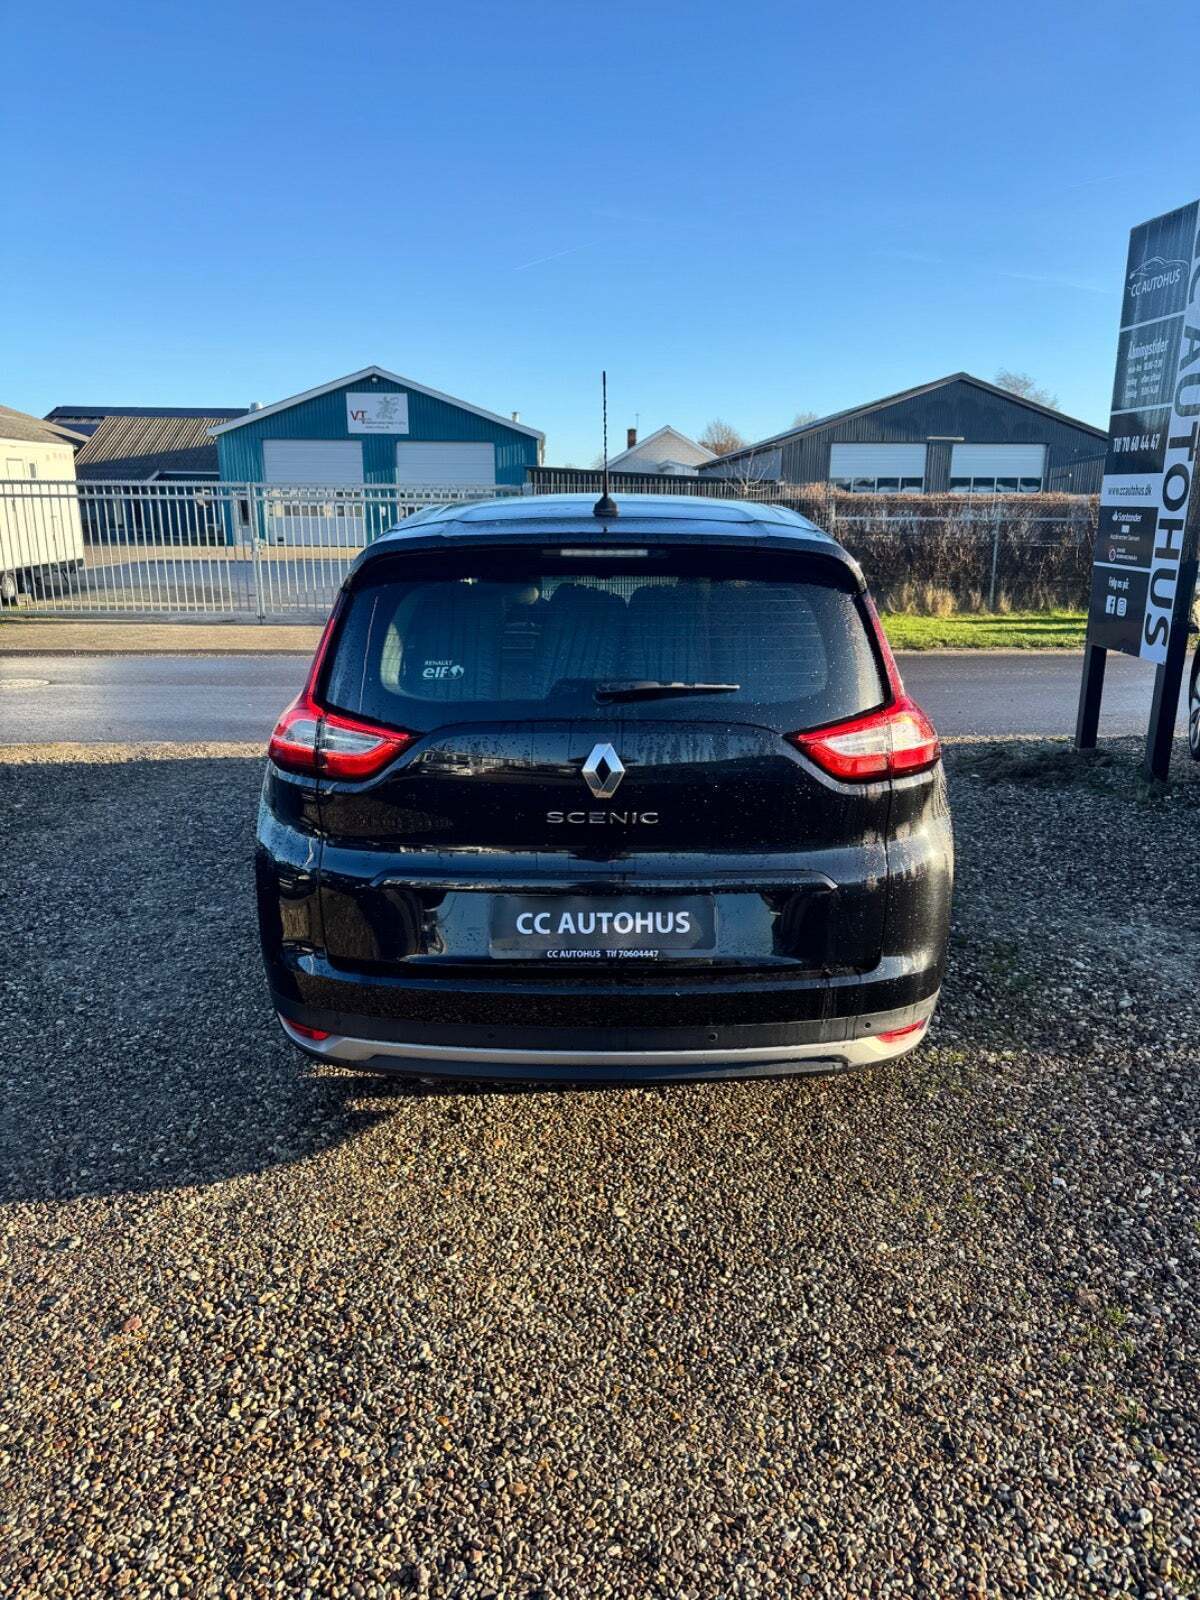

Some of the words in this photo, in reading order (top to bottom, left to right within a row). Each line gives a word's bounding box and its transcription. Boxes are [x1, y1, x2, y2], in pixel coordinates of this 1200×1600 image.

[1130, 282, 1142, 297] CC
[1141, 268, 1181, 294] AUTOHUS
[1122, 436, 1131, 452] 70
[1130, 435, 1140, 451] 60
[1140, 434, 1149, 451] 44
[1150, 433, 1161, 450] 47
[546, 811, 659, 824] SCENIC
[516, 913, 551, 934] CC
[557, 912, 690, 934] AUTOHUS
[547, 950, 558, 958] CC
[559, 950, 601, 958] AUTOHUS
[618, 950, 659, 958] 70604447
